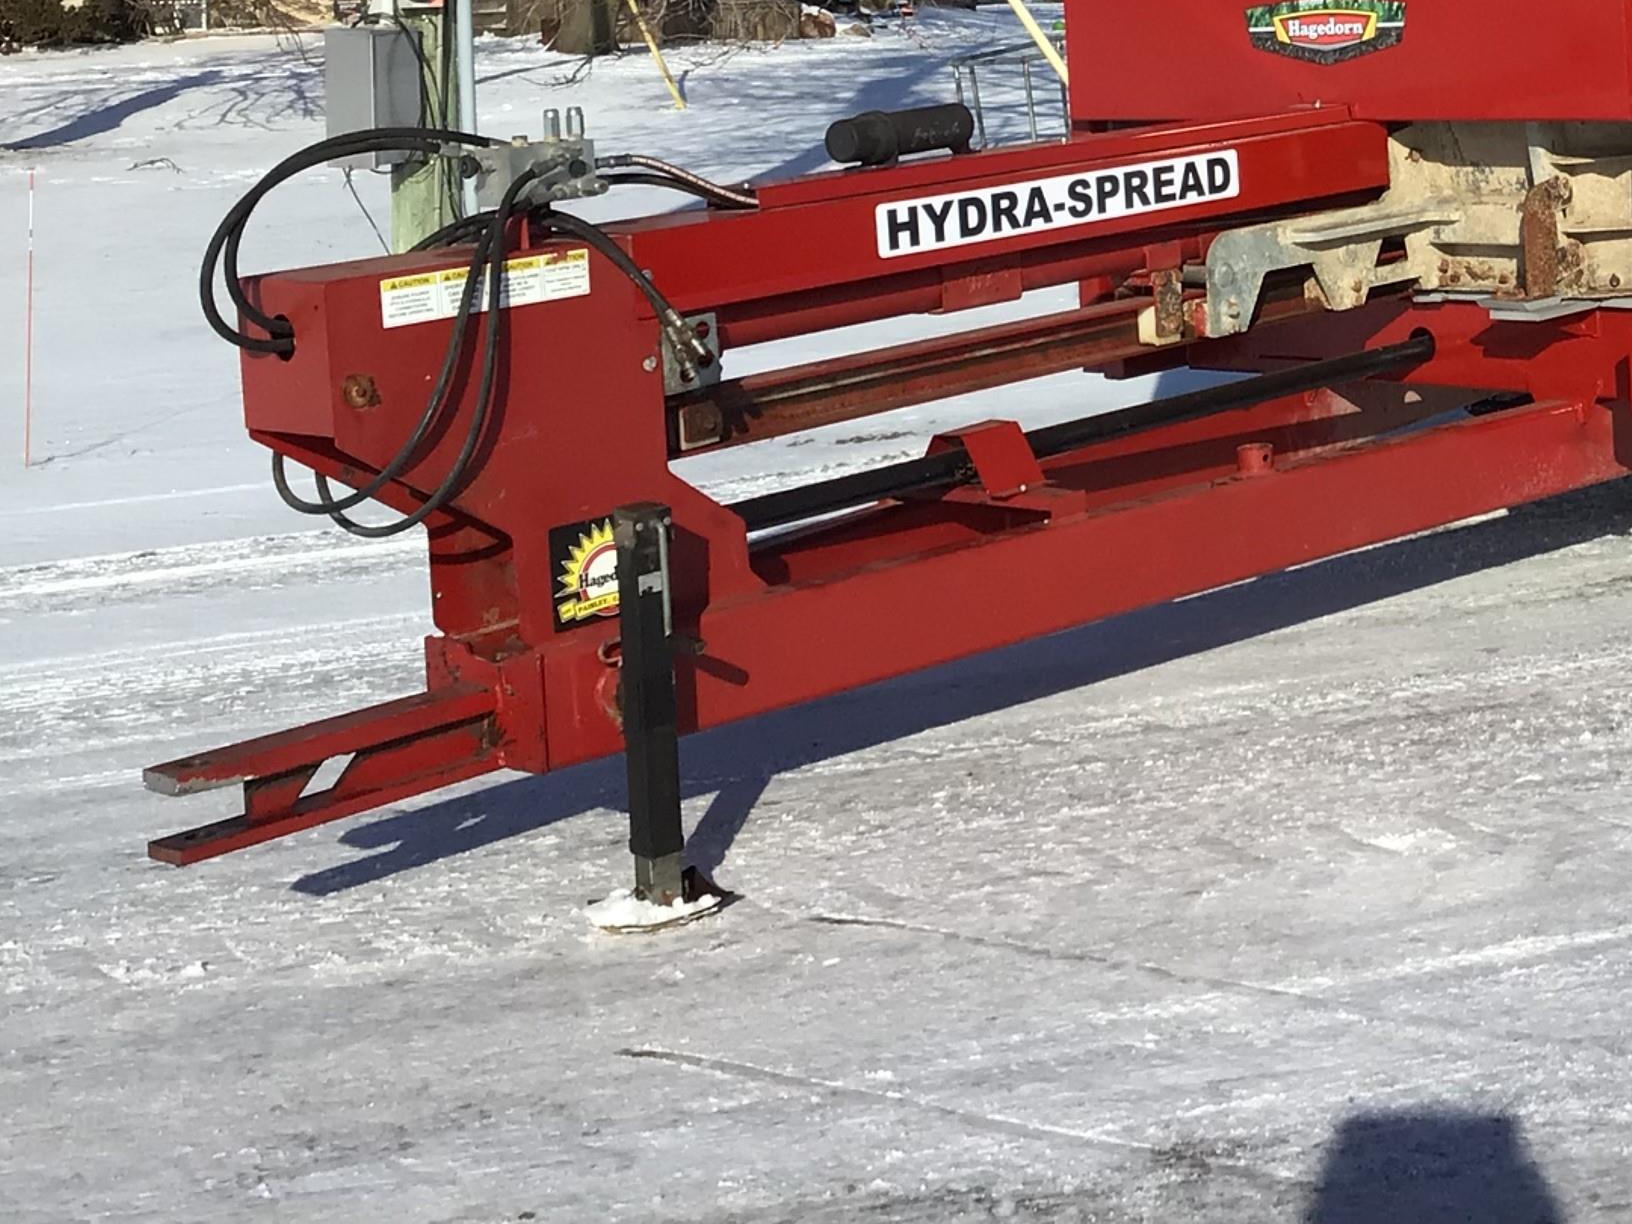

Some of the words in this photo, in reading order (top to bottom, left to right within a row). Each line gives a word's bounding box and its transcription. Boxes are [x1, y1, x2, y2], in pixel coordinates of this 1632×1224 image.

[1287, 17, 1363, 39] Hagedorn
[887, 157, 1232, 251] HYDRA-SPREAD
[398, 277, 430, 288] CAUTION
